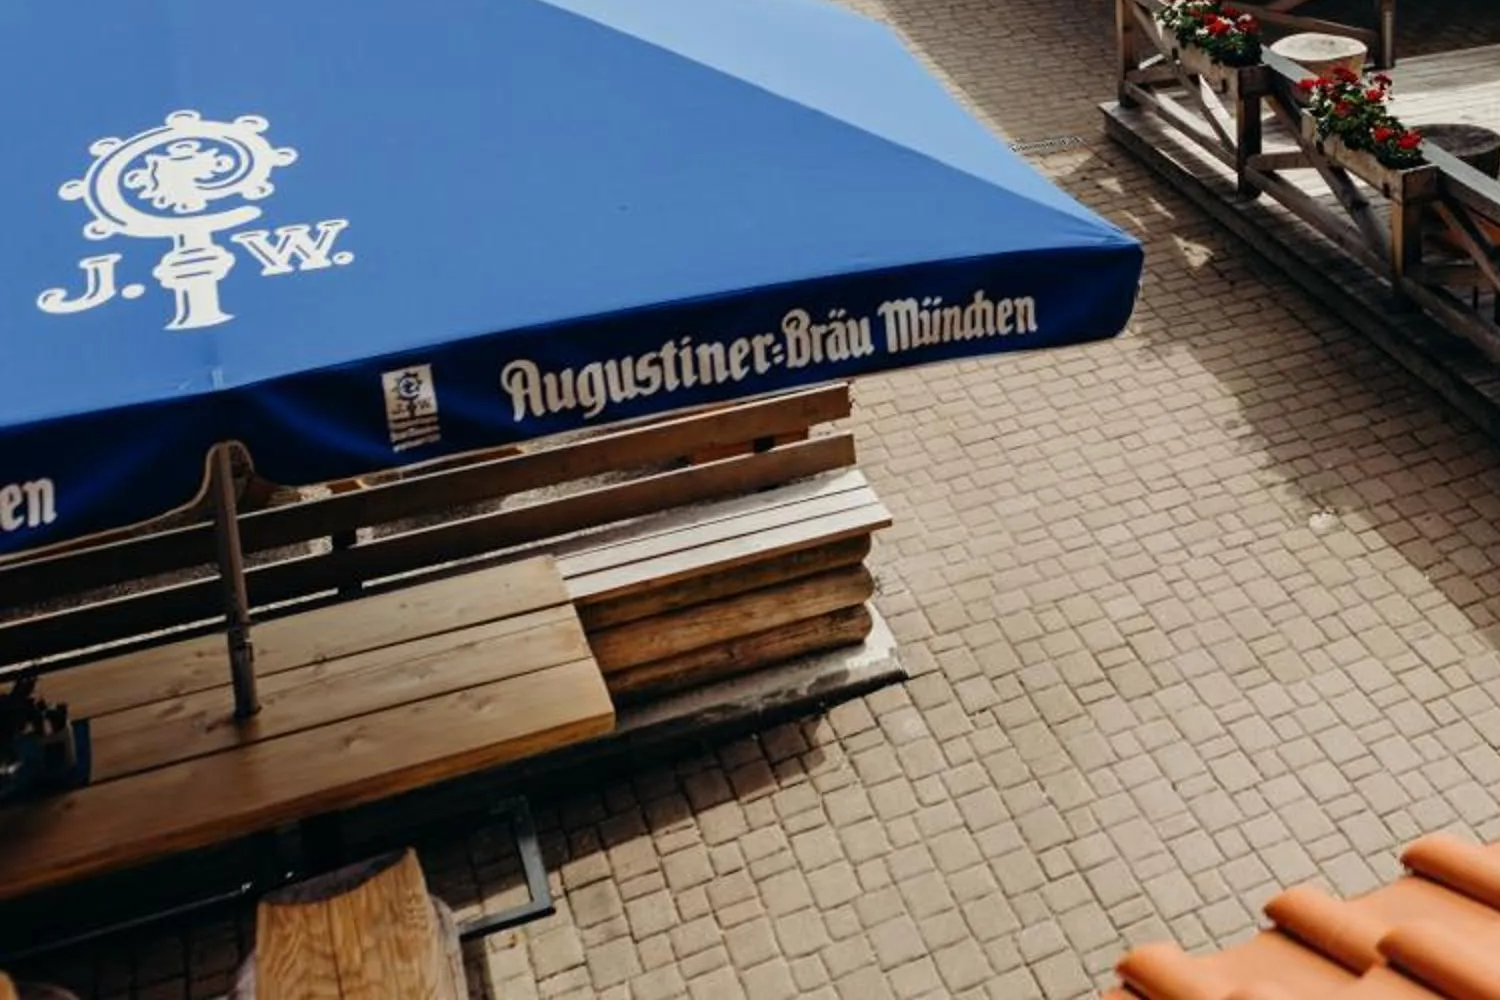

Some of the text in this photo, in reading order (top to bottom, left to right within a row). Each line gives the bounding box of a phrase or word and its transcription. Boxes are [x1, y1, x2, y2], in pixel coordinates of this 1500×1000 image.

[37, 218, 355, 314] J. W.
[502, 289, 1038, 422] Augustiner-Bräu München
